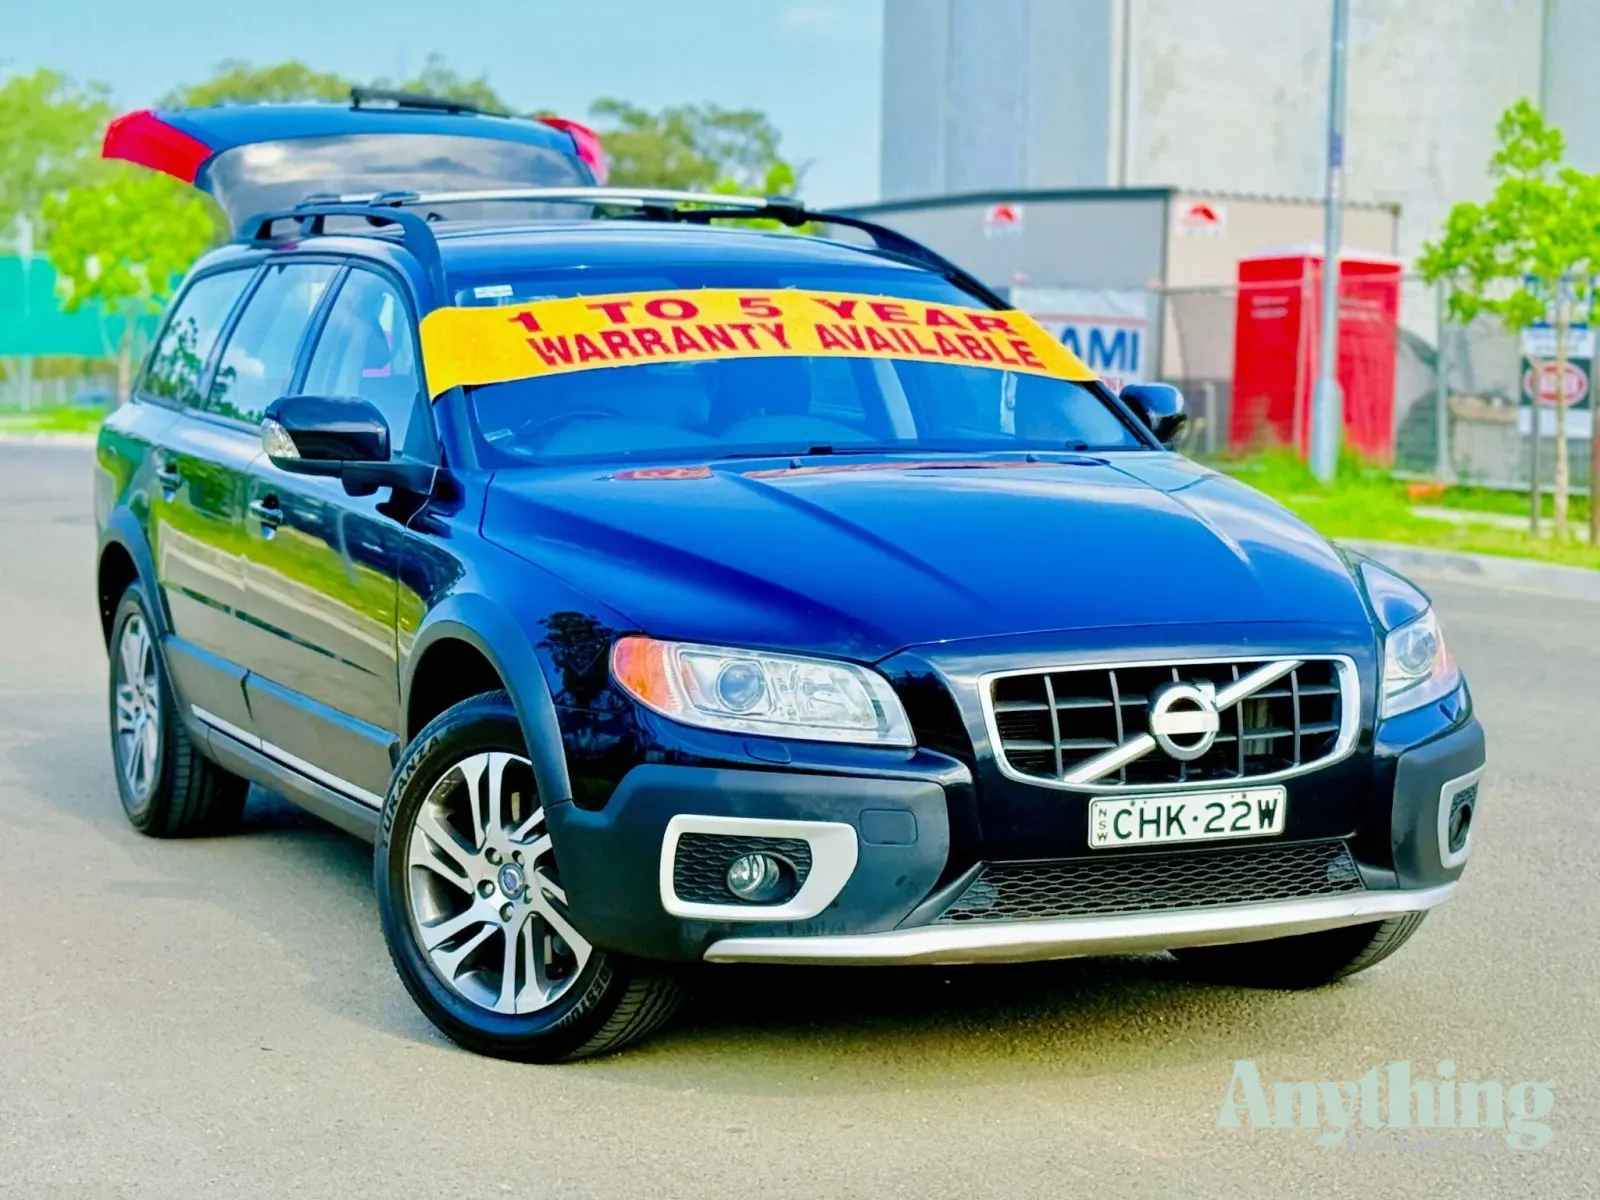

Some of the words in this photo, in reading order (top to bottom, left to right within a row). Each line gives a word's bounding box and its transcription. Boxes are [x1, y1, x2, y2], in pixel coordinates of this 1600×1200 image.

[508, 311, 543, 332] 1
[586, 298, 699, 324] TO
[739, 297, 783, 318] 5
[811, 298, 1021, 336] YEAR
[525, 323, 792, 367] WARRANTY
[814, 324, 1047, 369] AVAILABLE
[1060, 326, 1138, 371] AMI
[1097, 808, 1108, 842] NSW
